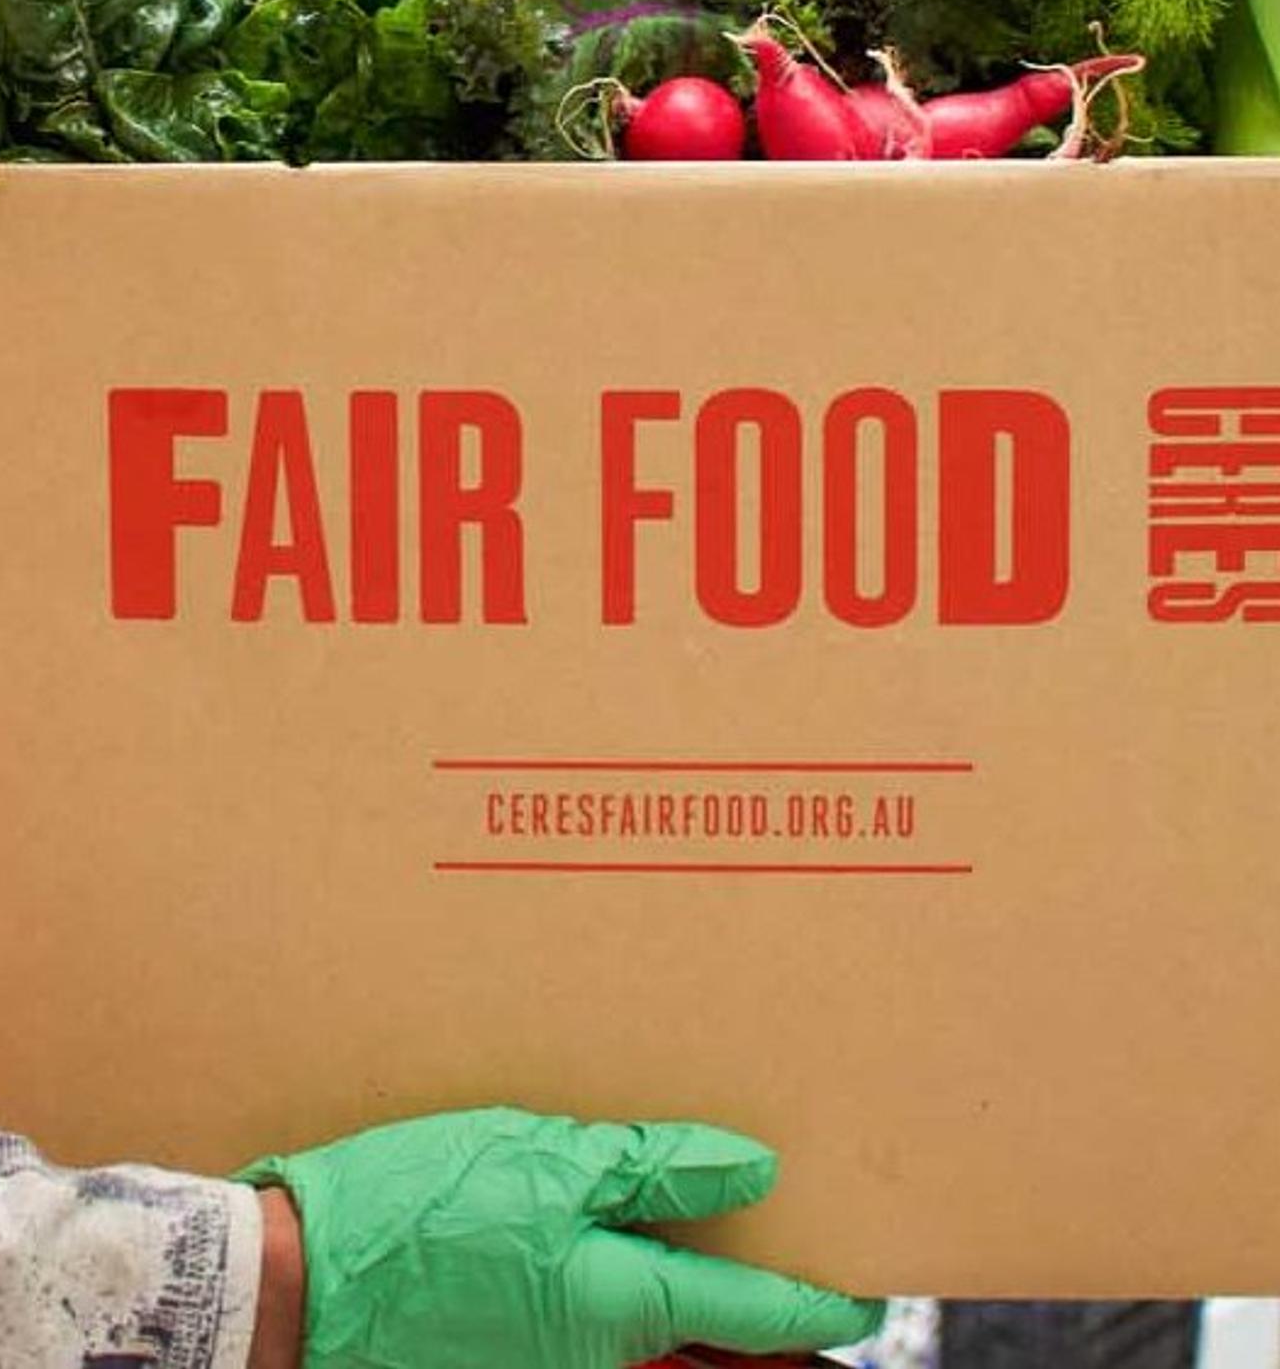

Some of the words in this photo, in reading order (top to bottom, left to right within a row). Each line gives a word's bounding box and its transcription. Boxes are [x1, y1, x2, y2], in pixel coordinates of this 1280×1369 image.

[106, 386, 527, 626] FAIR
[599, 385, 1073, 631] FOOD
[486, 792, 916, 840] CERESFAIRFOOD.ORG.AU
